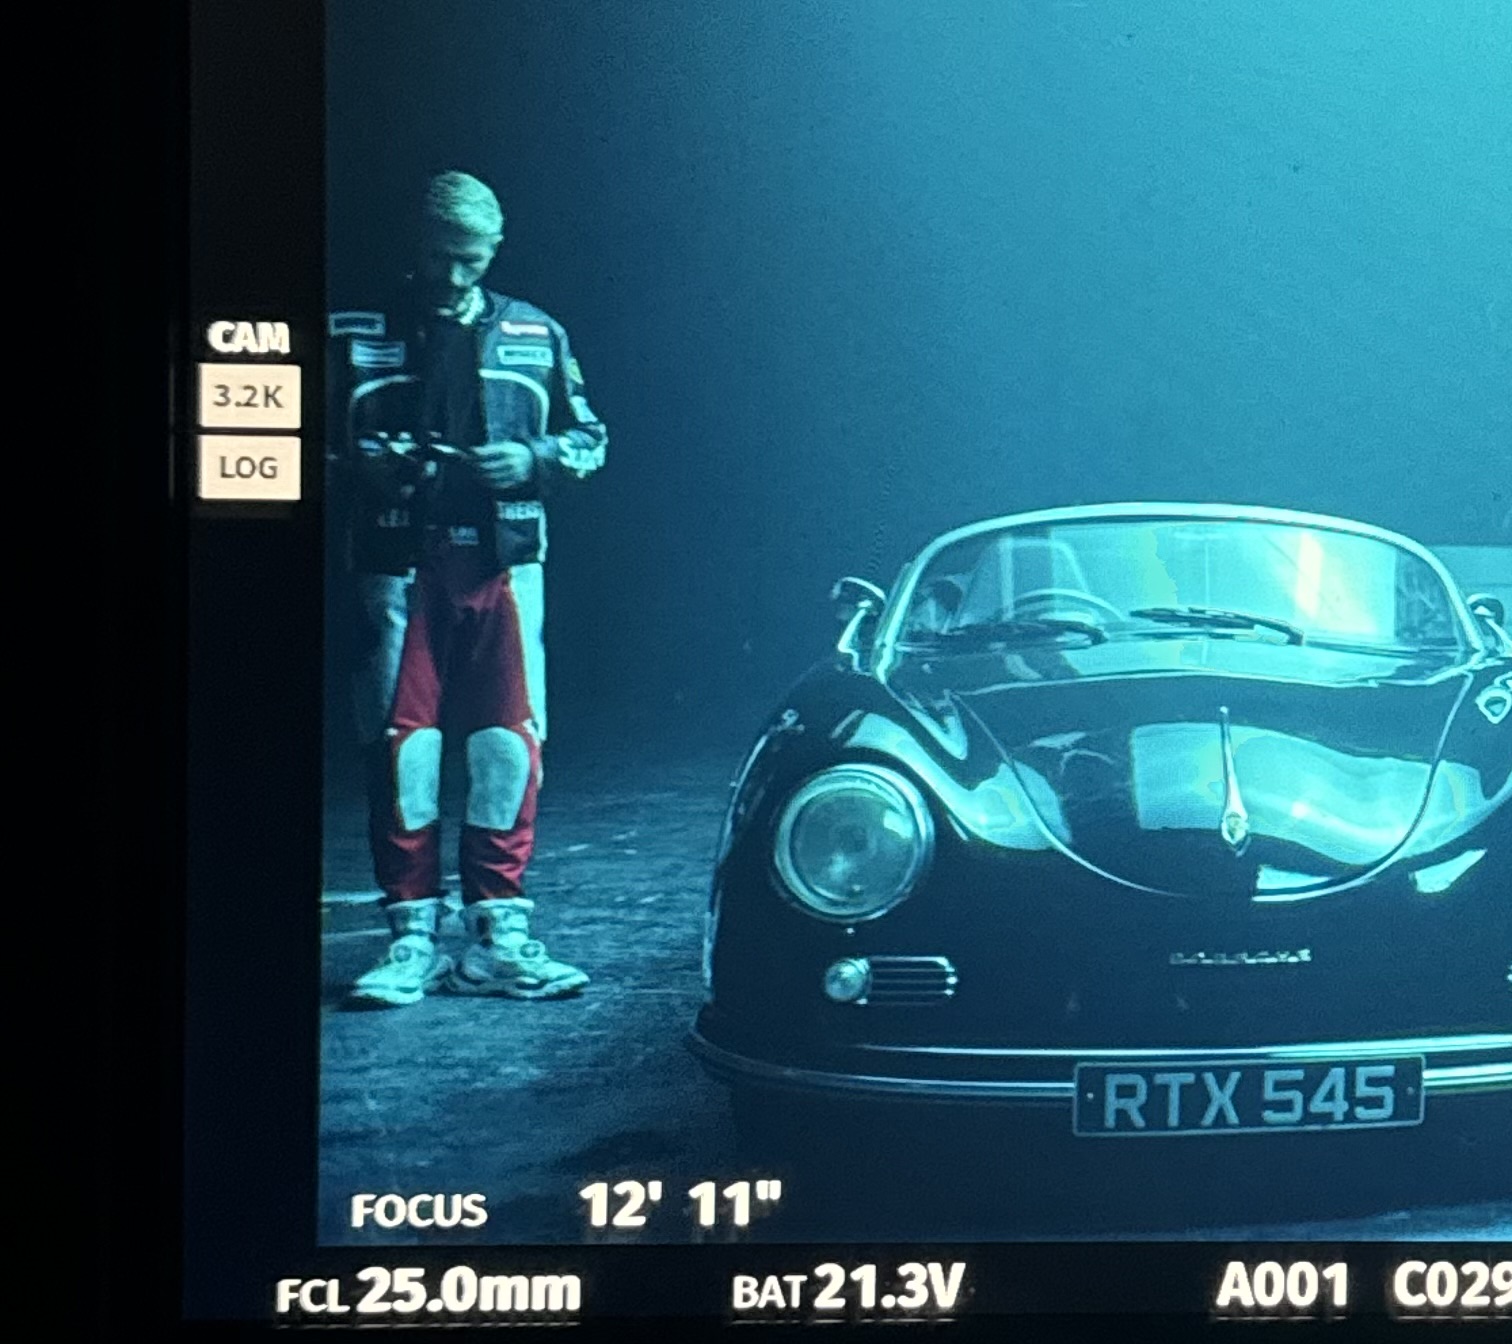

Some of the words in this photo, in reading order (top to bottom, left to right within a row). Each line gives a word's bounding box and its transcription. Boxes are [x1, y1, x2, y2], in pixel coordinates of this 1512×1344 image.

[207, 320, 291, 355] CAM
[212, 384, 284, 408] 3.2K
[219, 456, 279, 479] LOG
[1104, 1071, 1242, 1129] RTX
[1261, 1065, 1397, 1124] 545
[351, 1192, 488, 1228] FOCUS
[579, 1180, 662, 1227] 12'
[688, 1180, 783, 1227] 11"
[276, 1278, 351, 1313] FCL
[356, 1265, 581, 1313] 25.0mm
[732, 1274, 809, 1310] BAT
[813, 1262, 967, 1310] 21.3V
[1215, 1260, 1349, 1308] A001
